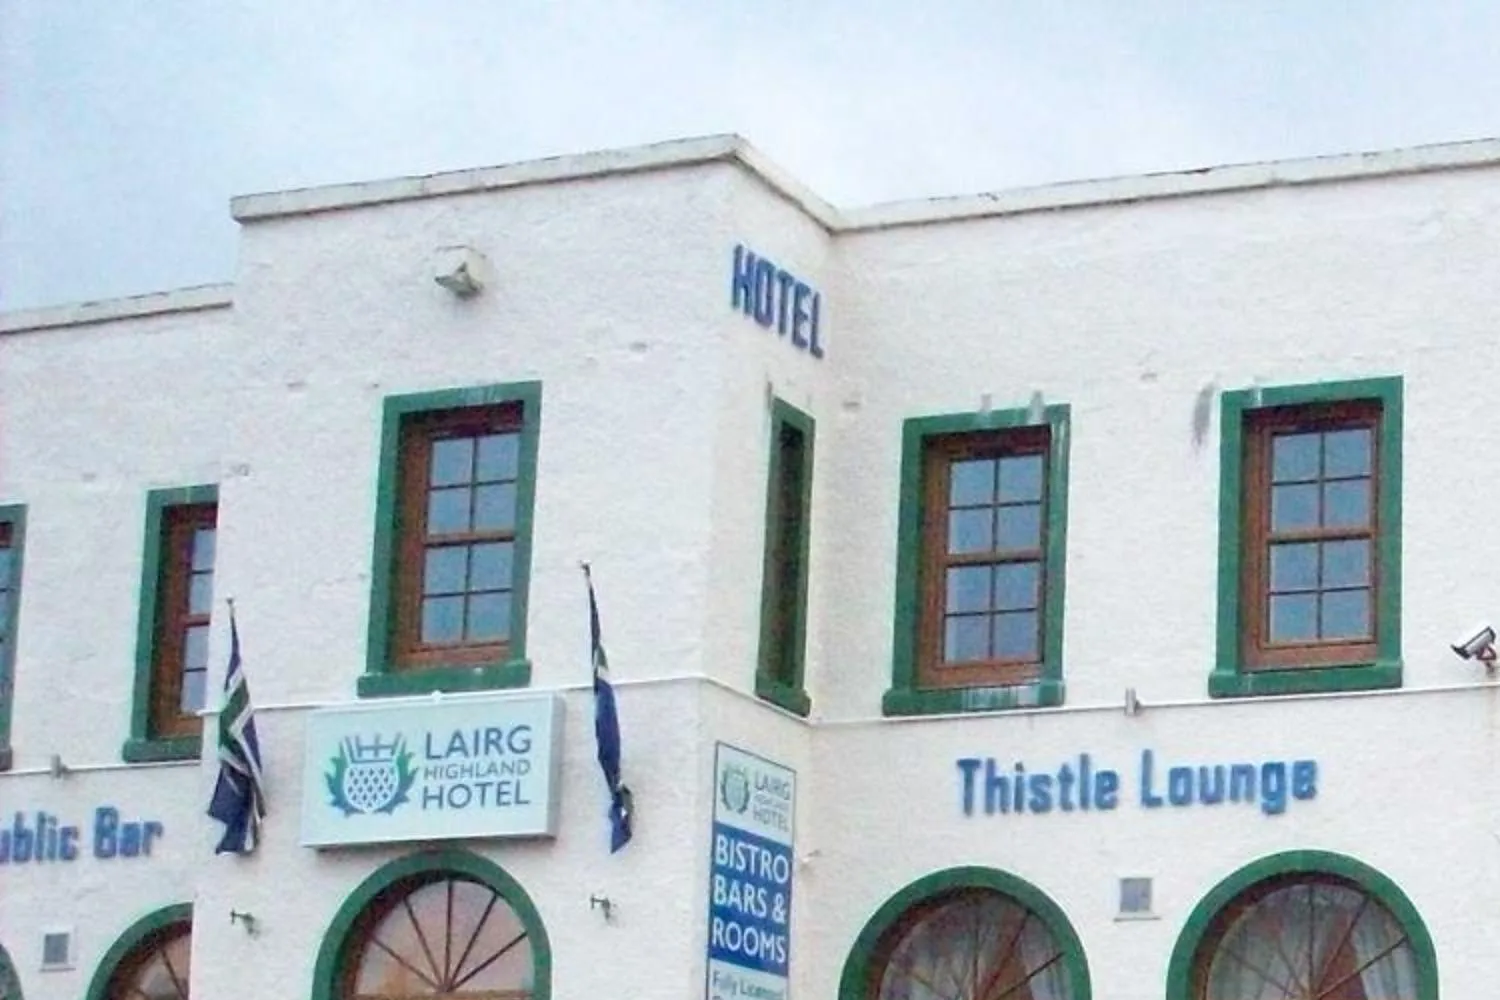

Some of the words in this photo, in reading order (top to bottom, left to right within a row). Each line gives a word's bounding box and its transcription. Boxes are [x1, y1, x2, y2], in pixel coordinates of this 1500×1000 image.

[731, 243, 824, 360] HOTEL
[425, 724, 533, 760] LAIRG
[422, 779, 531, 810] HOTEL
[423, 758, 531, 781] HIGHLAND
[956, 752, 1119, 816] Thistle
[1140, 748, 1318, 815] Lounge
[0, 809, 80, 864] ublic
[94, 806, 164, 859] Bar
[714, 833, 789, 884] BISTRO
[713, 874, 767, 918] BARS
[771, 892, 787, 924] &
[712, 916, 787, 964] ROOMS
